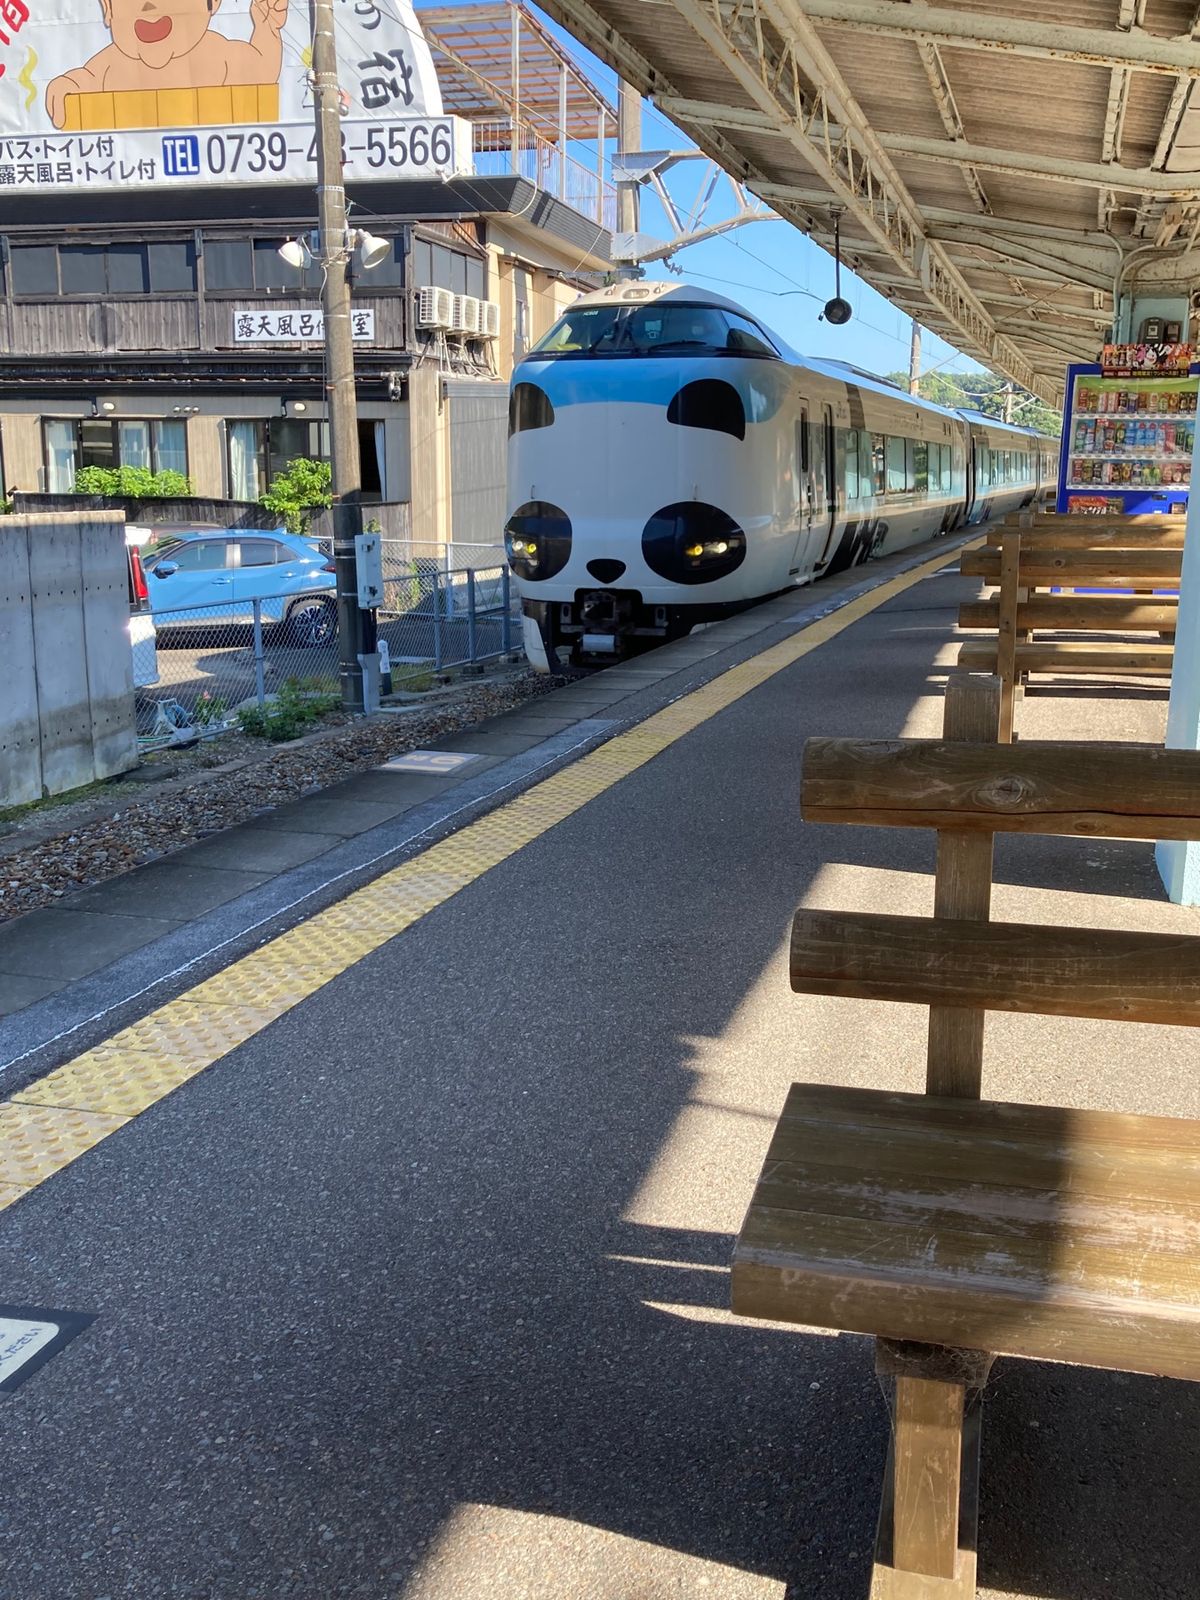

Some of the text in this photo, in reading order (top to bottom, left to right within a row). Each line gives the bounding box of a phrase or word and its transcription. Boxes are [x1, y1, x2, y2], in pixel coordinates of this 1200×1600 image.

[0, 158, 156, 185] 露天風呂・トイレ付
[163, 138, 199, 174] TEL
